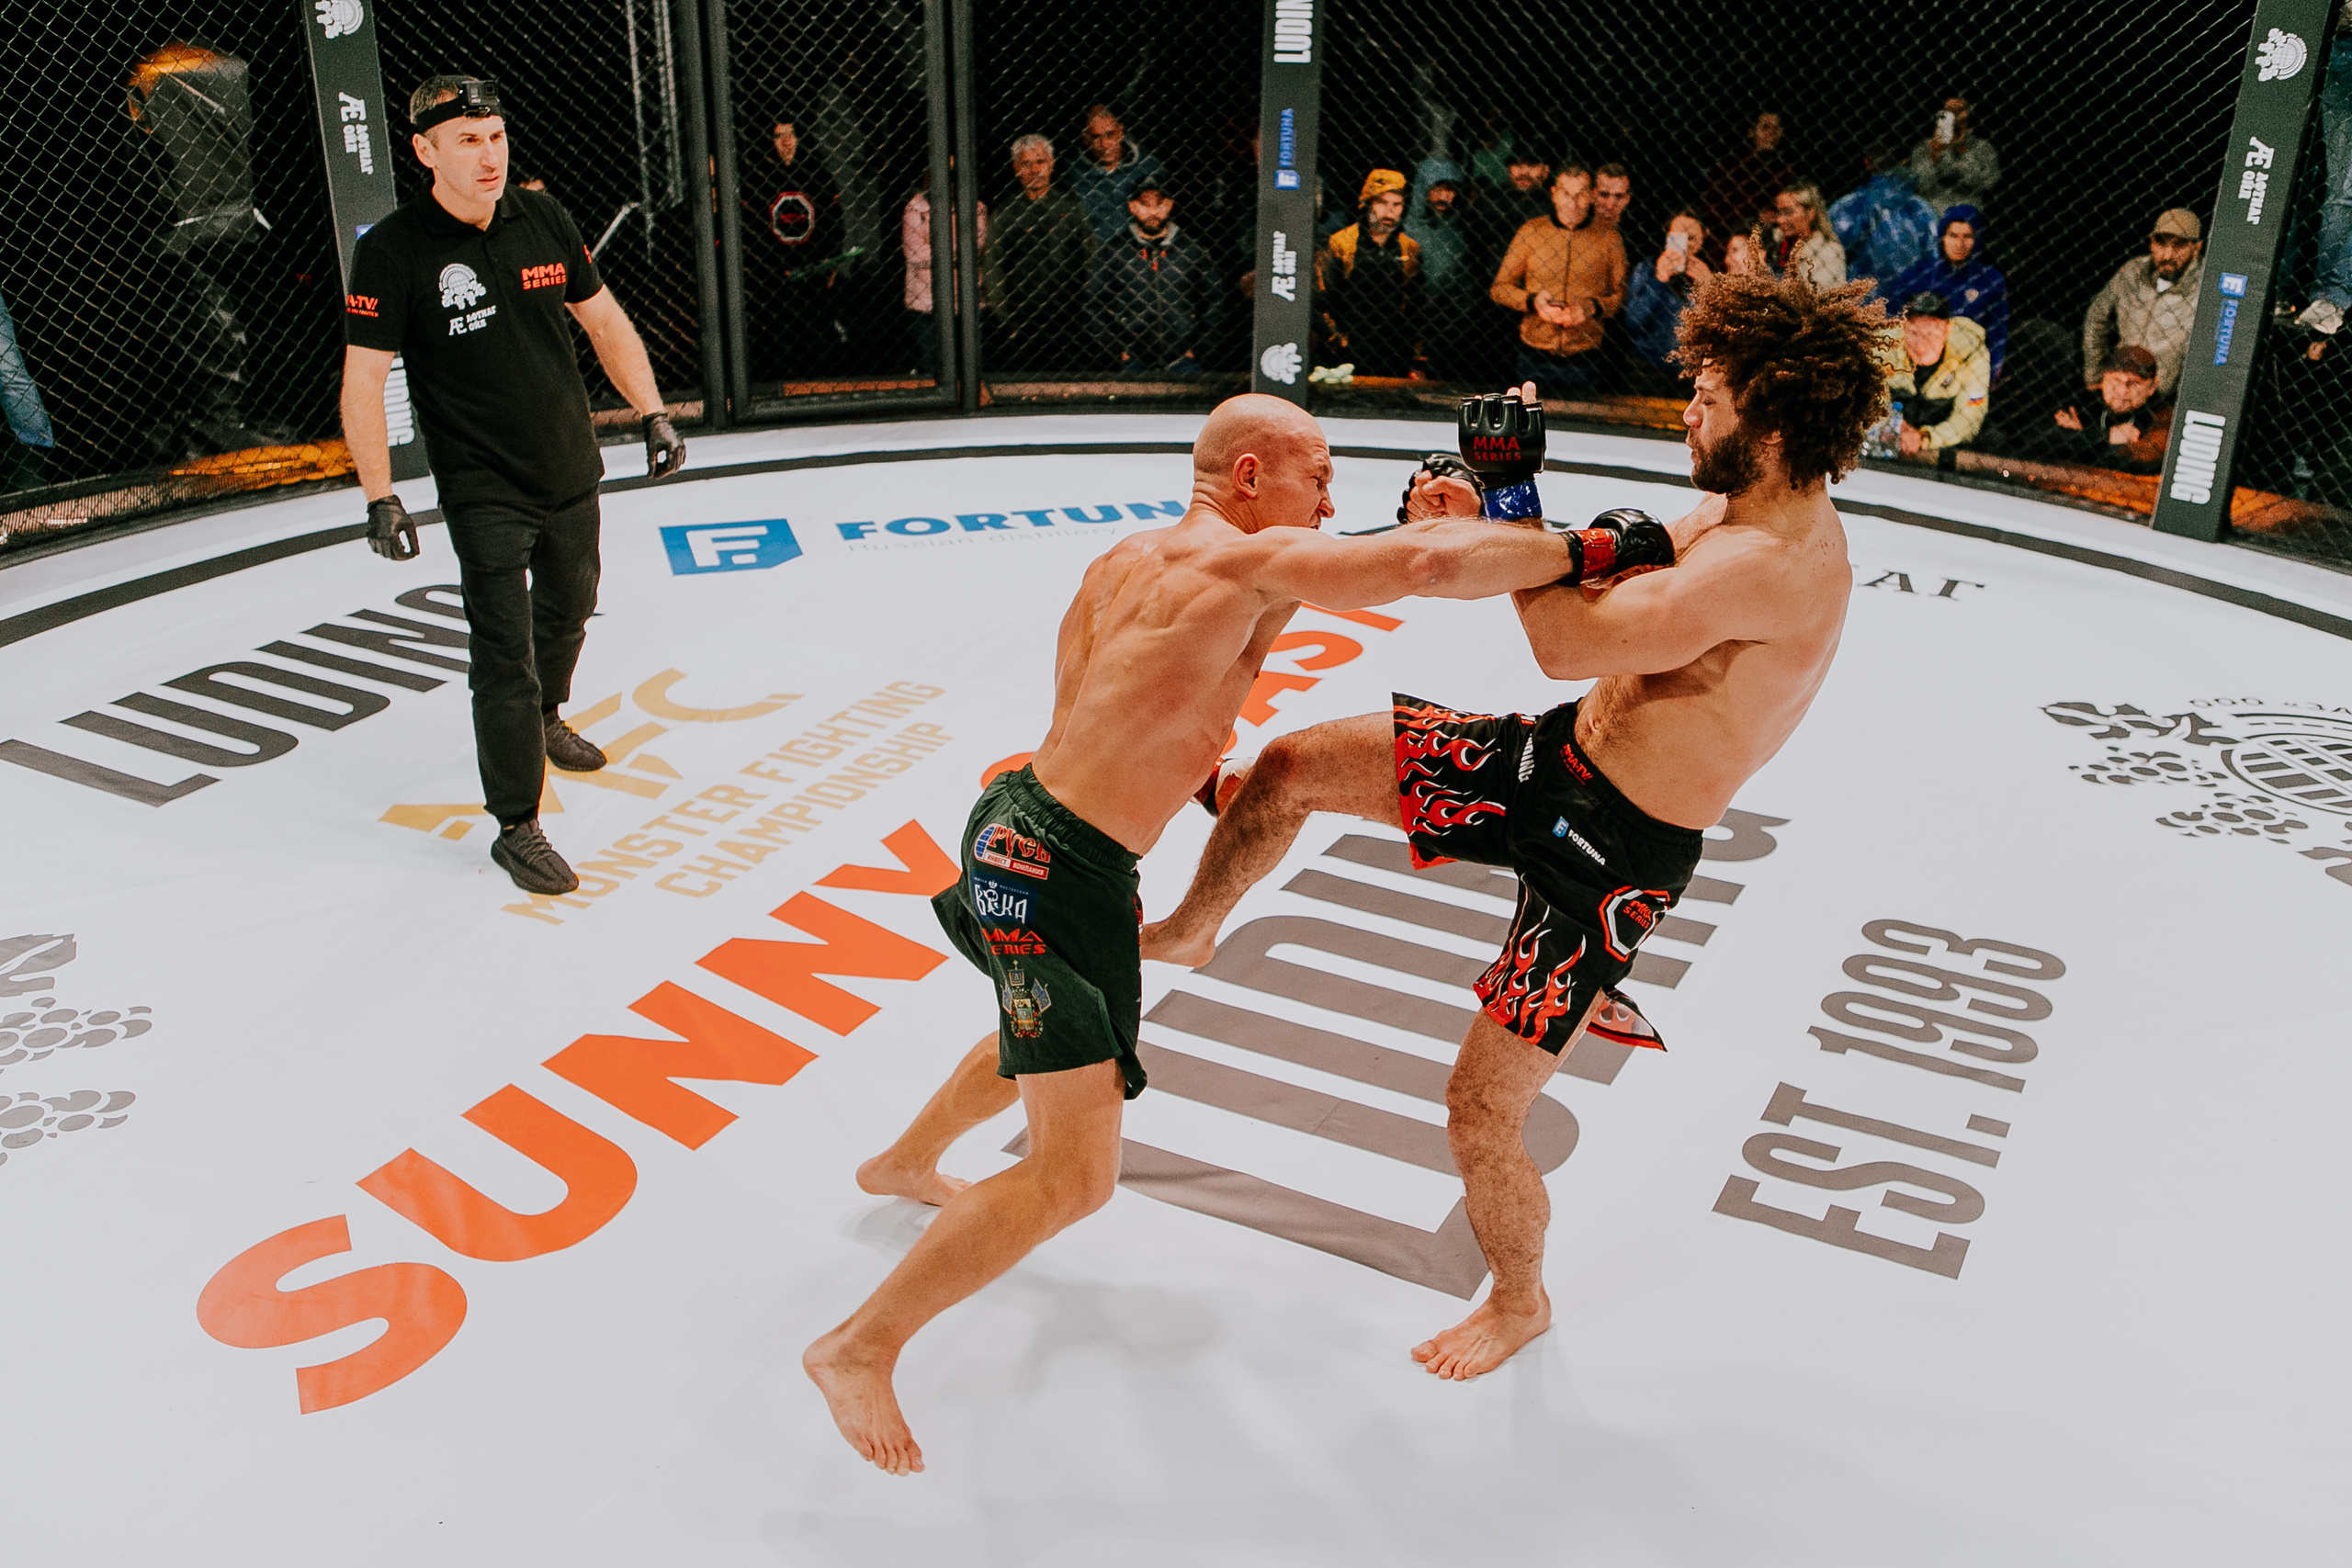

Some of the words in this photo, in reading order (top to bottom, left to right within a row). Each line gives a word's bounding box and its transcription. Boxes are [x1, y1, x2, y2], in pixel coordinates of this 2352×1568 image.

[1273, 0, 1314, 63] LUDIN
[521, 262, 567, 281] MMA
[523, 275, 567, 290] SERIES
[2213, 299, 2239, 366] FORTUNA
[1473, 435, 1521, 450] MMA
[1474, 451, 1521, 461] SERIES
[2170, 410, 2226, 505] LUDING
[835, 501, 1185, 533] FORTUN
[500, 784, 770, 926] MONSTER
[738, 681, 946, 784] FIGHTING
[654, 722, 955, 898] CHAMPIONSHIP
[987, 854, 1008, 865] ИНВЕСТ
[988, 826, 1051, 863] РУСЬ
[1567, 829, 1606, 866] FORTUNA
[981, 928, 1045, 943] MMA
[1623, 906, 1651, 930] SERIES
[990, 943, 1046, 956] ERIES
[1806, 919, 2067, 1094] 1993
[196, 818, 963, 1416] SUNNY
[1712, 1081, 2011, 1280] EST.
